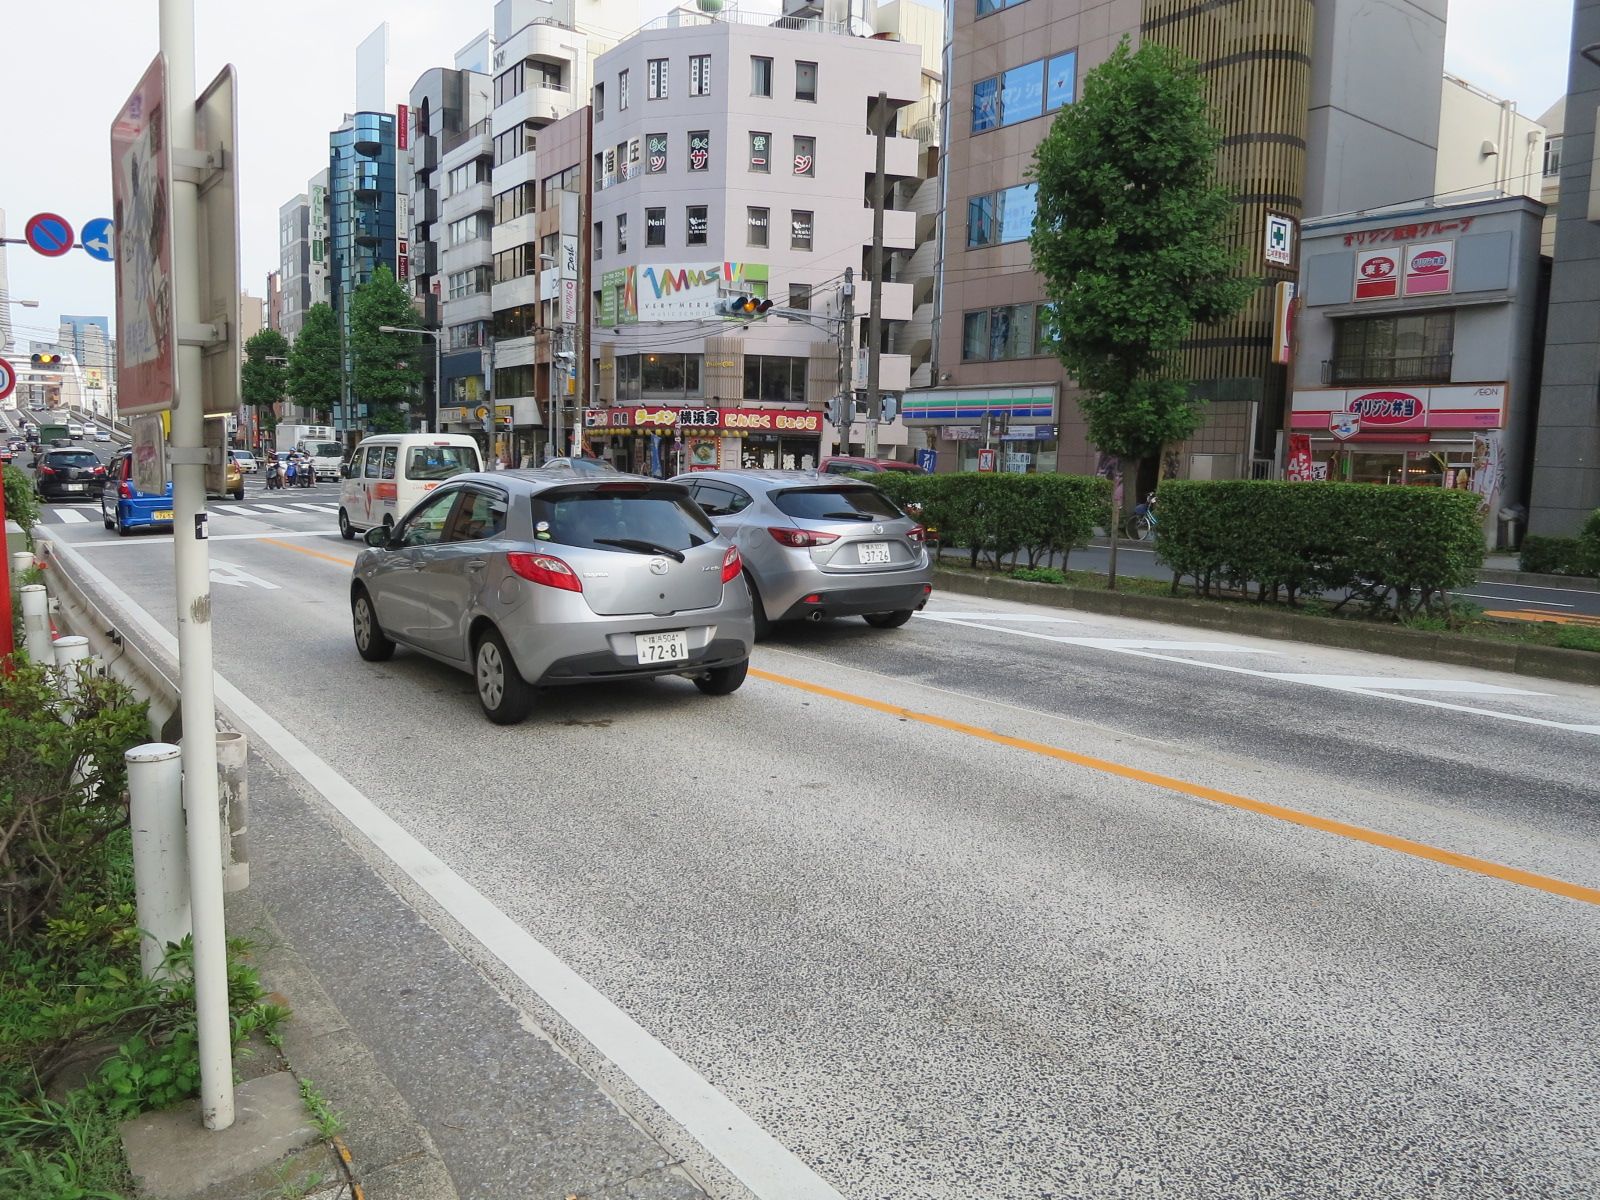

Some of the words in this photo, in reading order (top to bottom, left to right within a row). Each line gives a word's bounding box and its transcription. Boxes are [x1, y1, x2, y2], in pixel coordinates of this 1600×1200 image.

[690, 149, 708, 169] サ
[648, 218, 665, 226] Nail
[748, 218, 767, 226] Nail
[1353, 399, 1416, 417] オリジン弁当
[680, 410, 719, 426] 横浜家
[725, 413, 770, 428] にんにく
[865, 550, 889, 562] 37-26
[648, 643, 685, 661] 72-81
